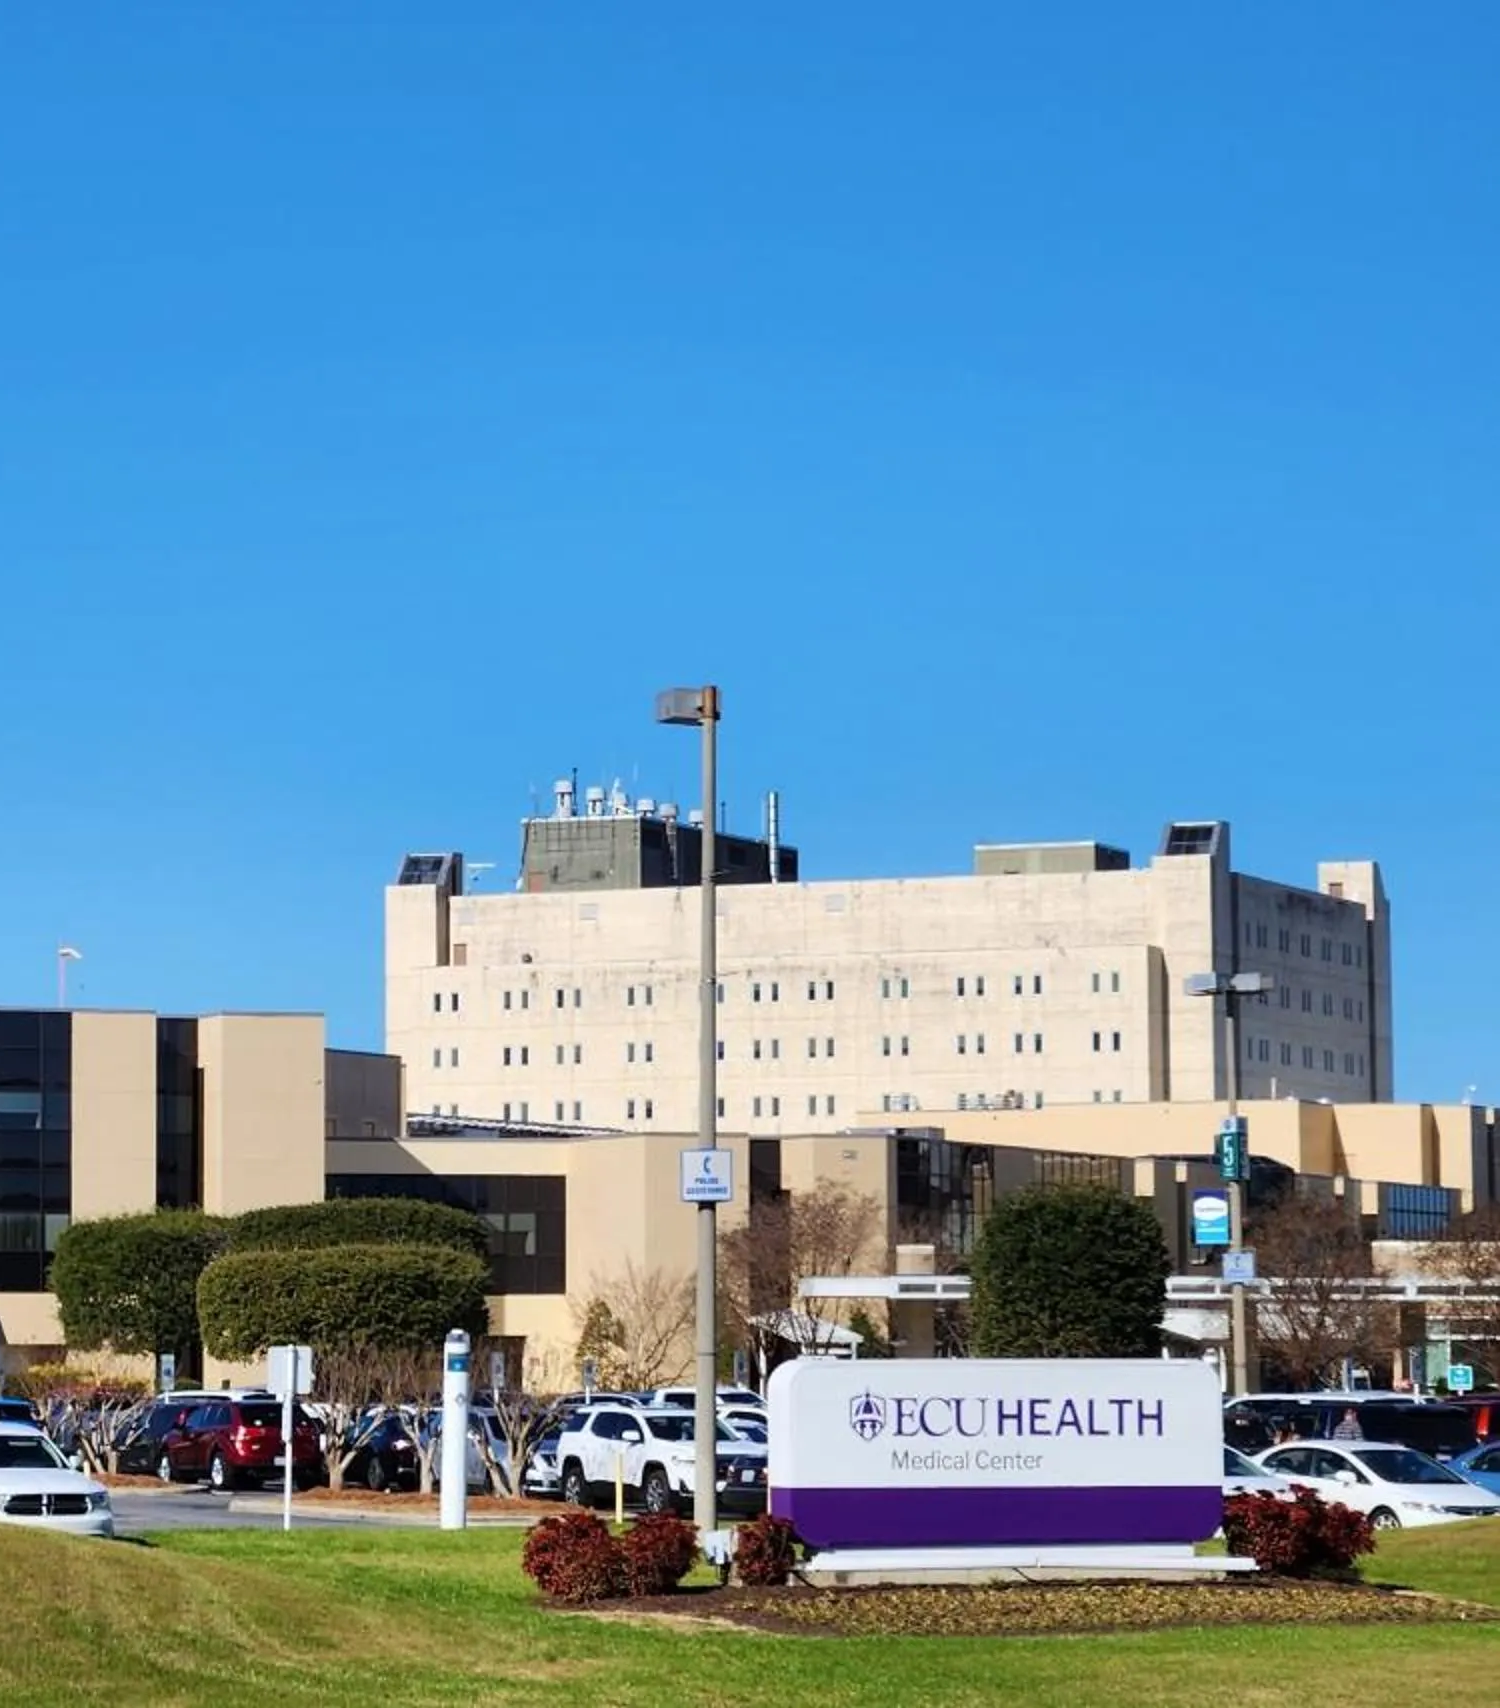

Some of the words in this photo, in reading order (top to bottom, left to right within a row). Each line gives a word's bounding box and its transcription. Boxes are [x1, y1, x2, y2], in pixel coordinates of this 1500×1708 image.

[1223, 1135, 1235, 1167] 5
[891, 1397, 988, 1438] ECU
[997, 1399, 1164, 1437] HEALTH
[891, 1450, 970, 1471] Medical
[975, 1451, 1044, 1471] Center
